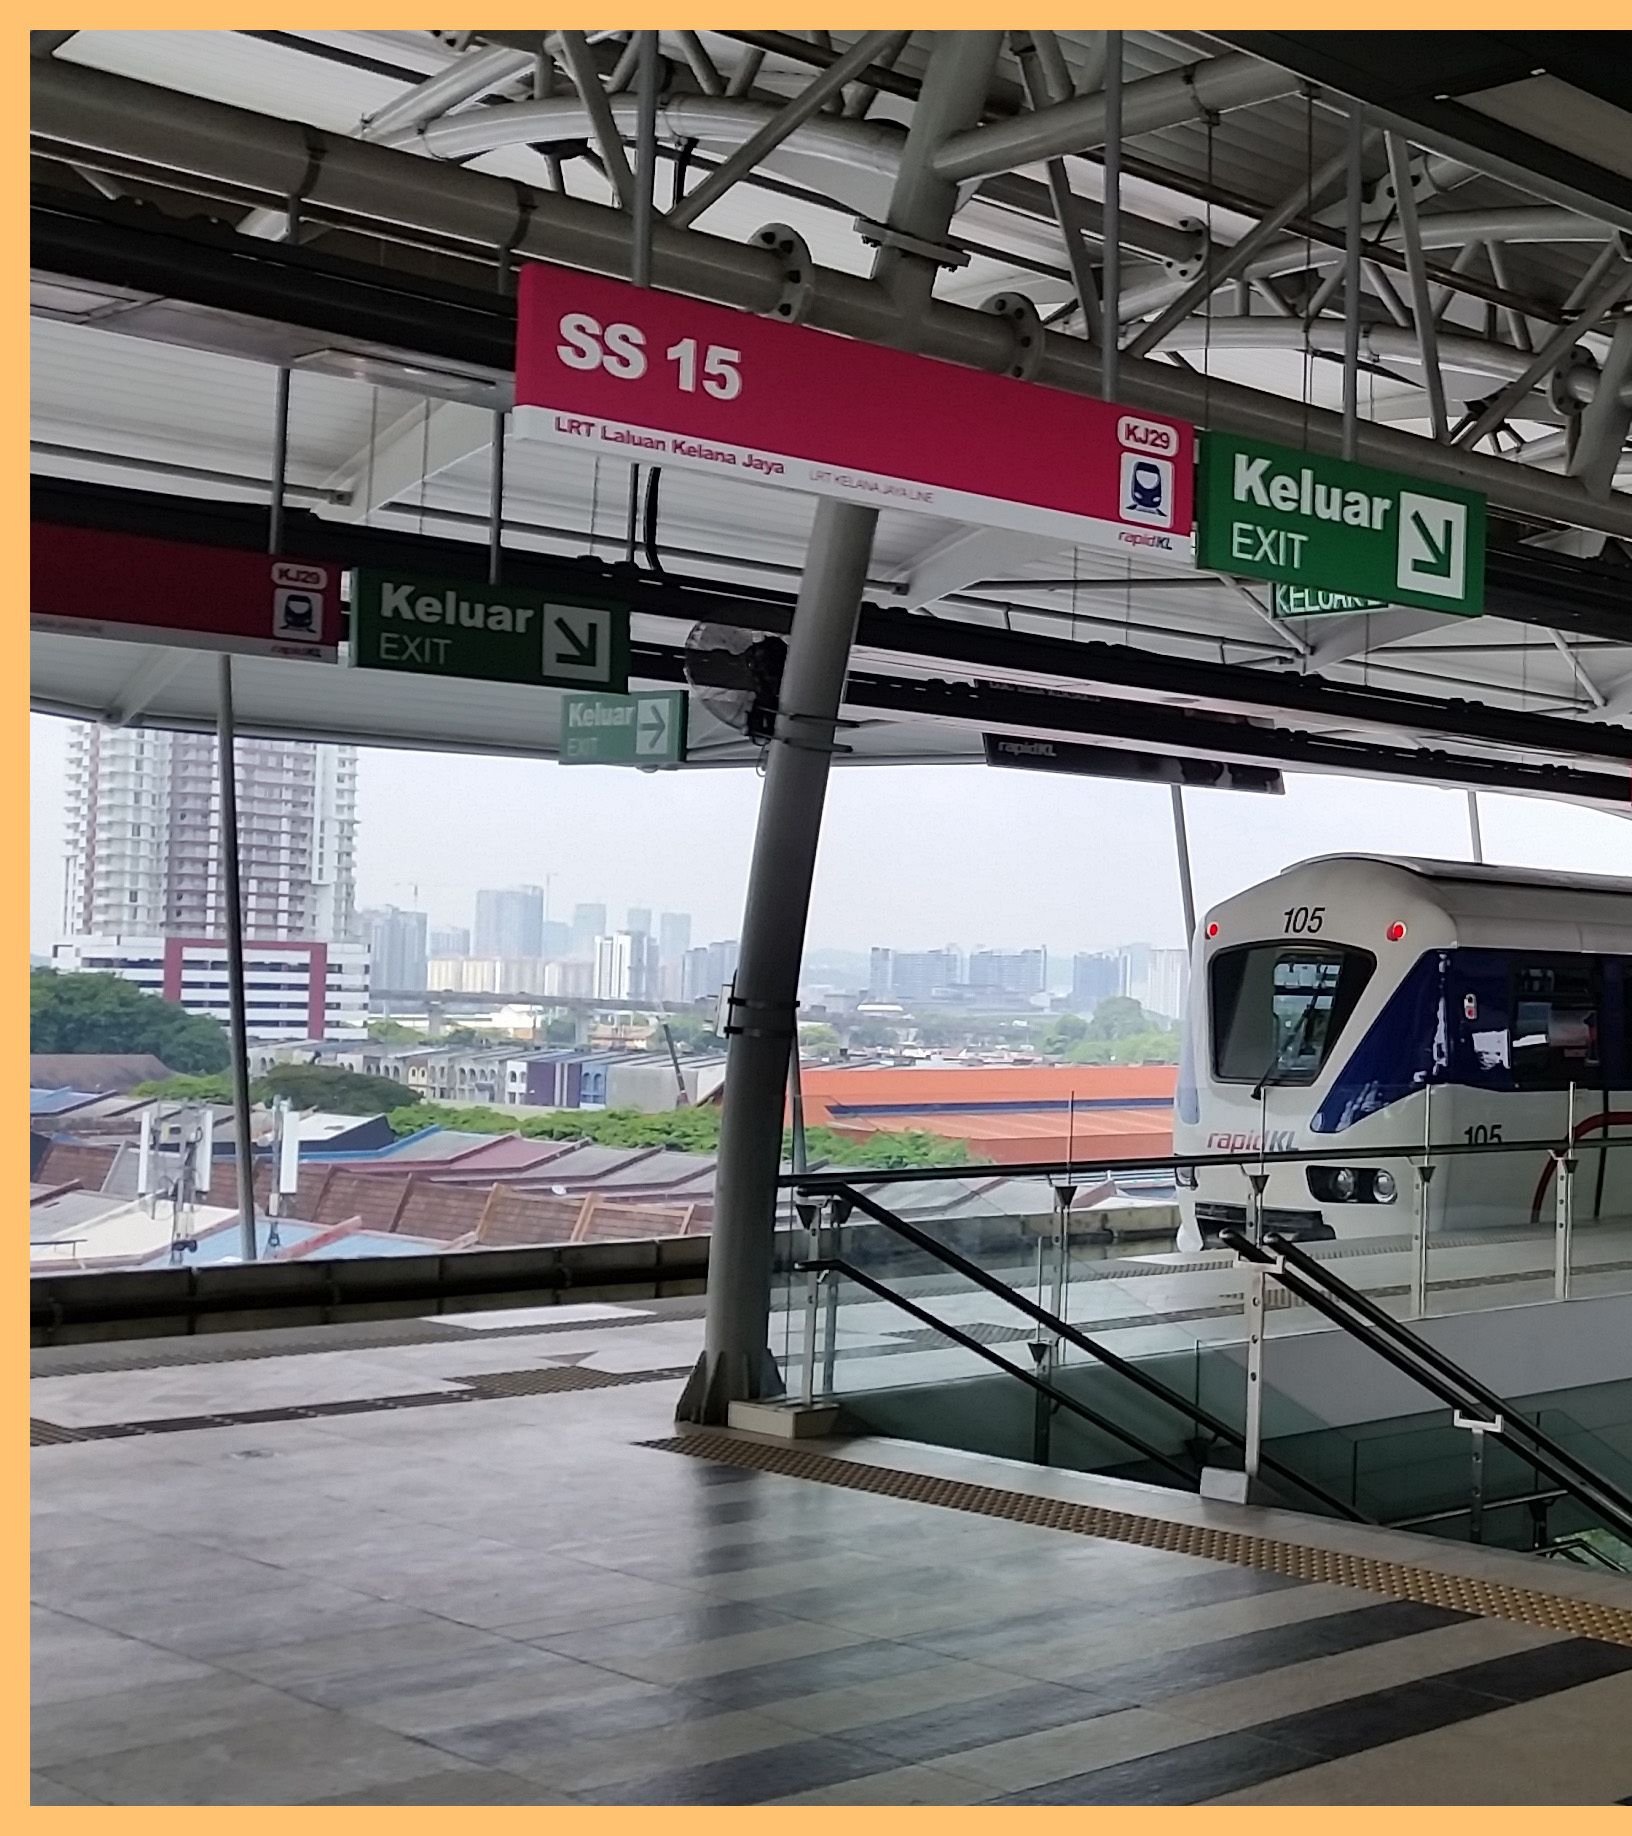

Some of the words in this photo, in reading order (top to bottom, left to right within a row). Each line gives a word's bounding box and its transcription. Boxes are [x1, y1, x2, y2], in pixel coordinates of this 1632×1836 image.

[557, 313, 648, 380] SS
[666, 337, 743, 400] 15
[554, 416, 596, 438] LRT
[601, 425, 666, 452] Laluan
[672, 439, 737, 465] Kelana
[742, 454, 785, 475] Jaya
[1124, 422, 1171, 450] KJ29
[1233, 452, 1393, 531] Keluar
[1118, 530, 1173, 551] rapidKL
[1231, 521, 1310, 570] EXIT
[380, 582, 535, 634] Keluar
[378, 631, 453, 666] EXIT
[568, 701, 636, 729] Keluar
[566, 737, 599, 758] EXIT
[1282, 906, 1326, 934] 105
[1207, 1130, 1299, 1153] rapidKL
[1463, 1124, 1503, 1144] 105
